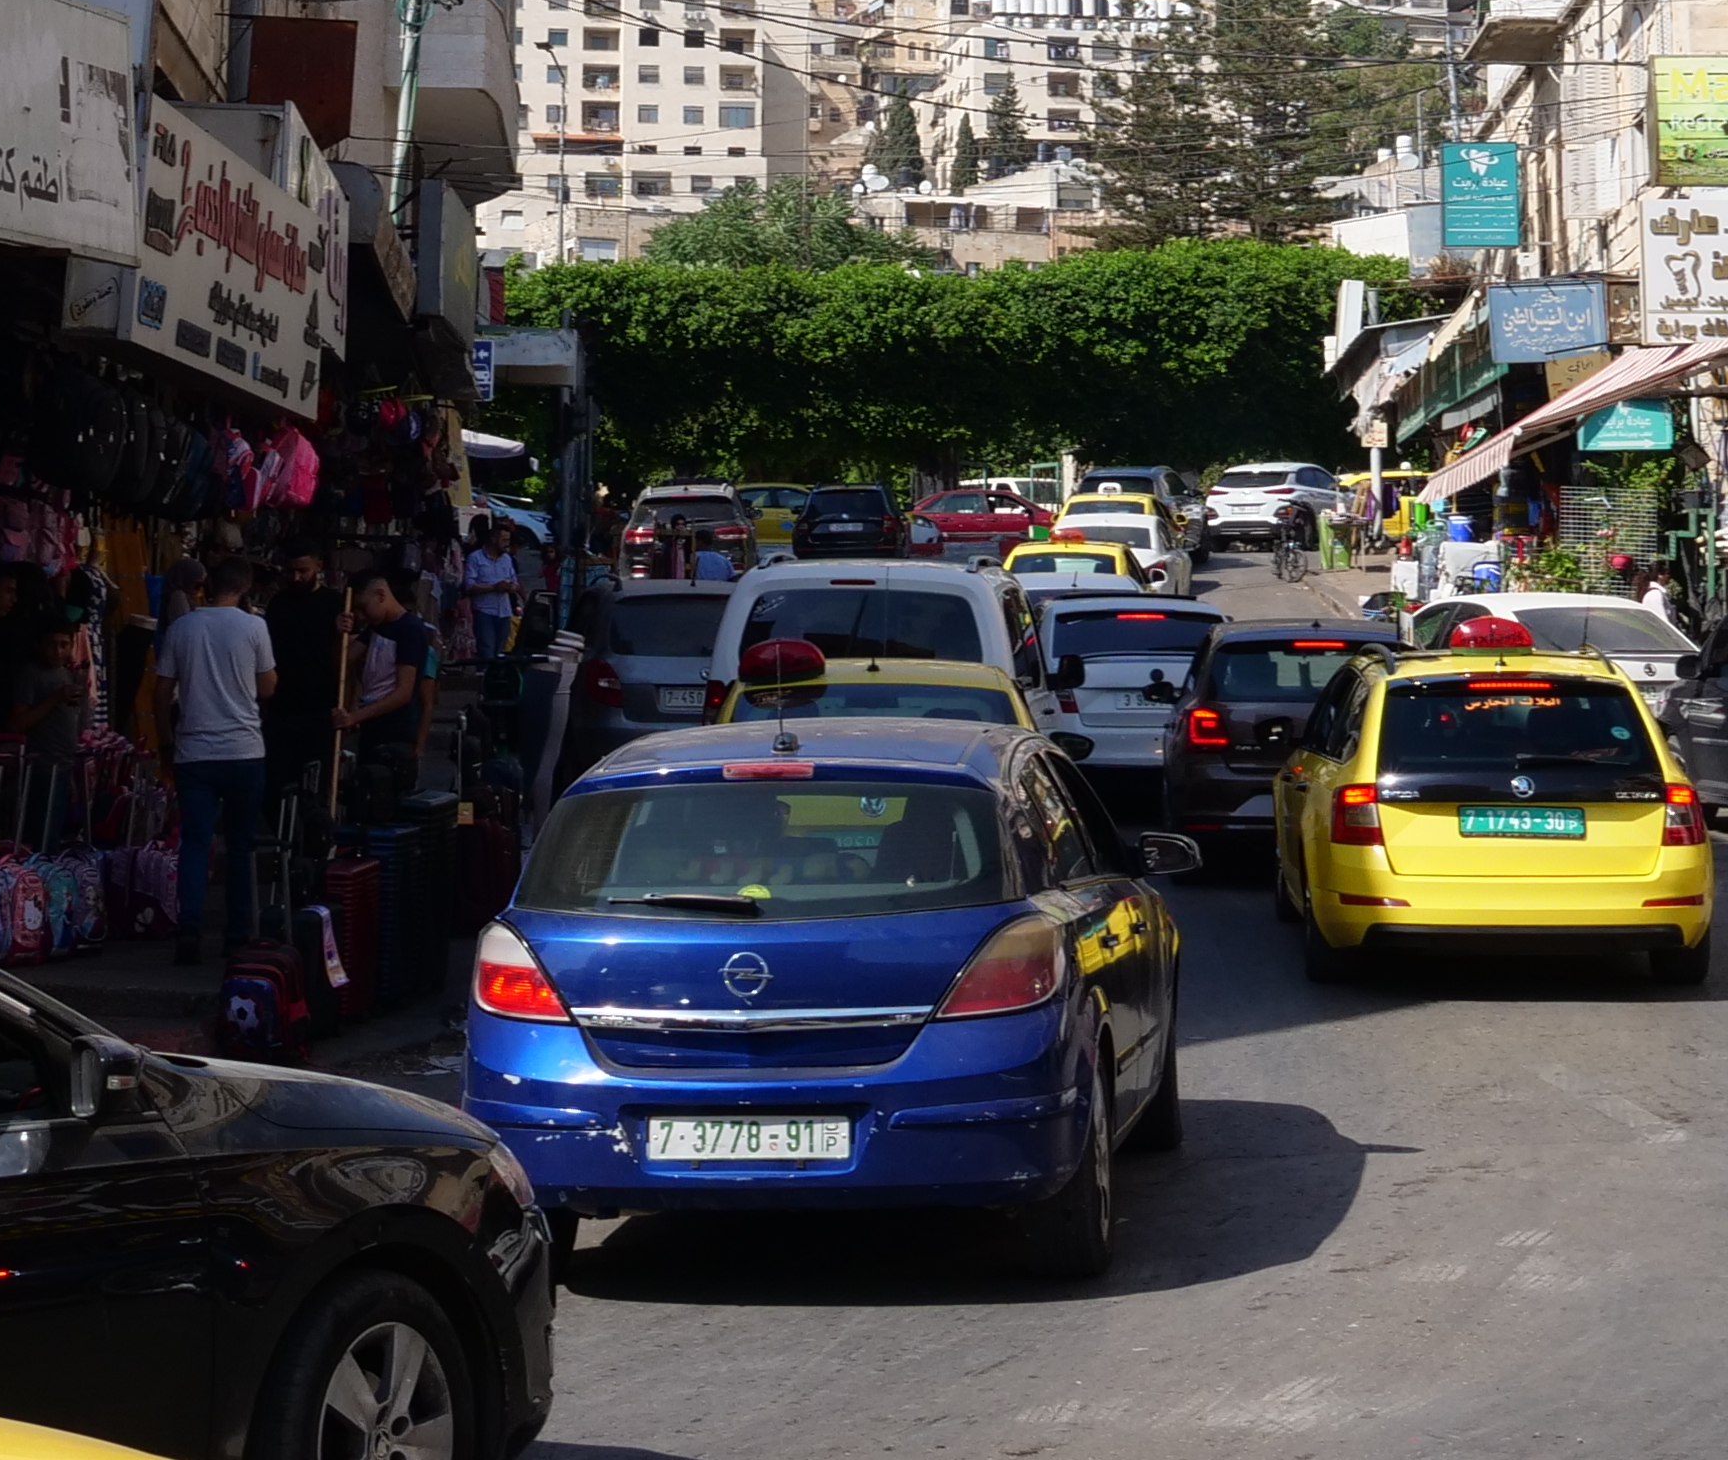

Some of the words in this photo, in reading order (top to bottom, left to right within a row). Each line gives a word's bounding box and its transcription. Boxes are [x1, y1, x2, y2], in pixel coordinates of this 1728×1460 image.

[1481, 177, 1508, 190] عيادة
[1567, 307, 1591, 330] ابن
[1626, 416, 1651, 429] عيادة
